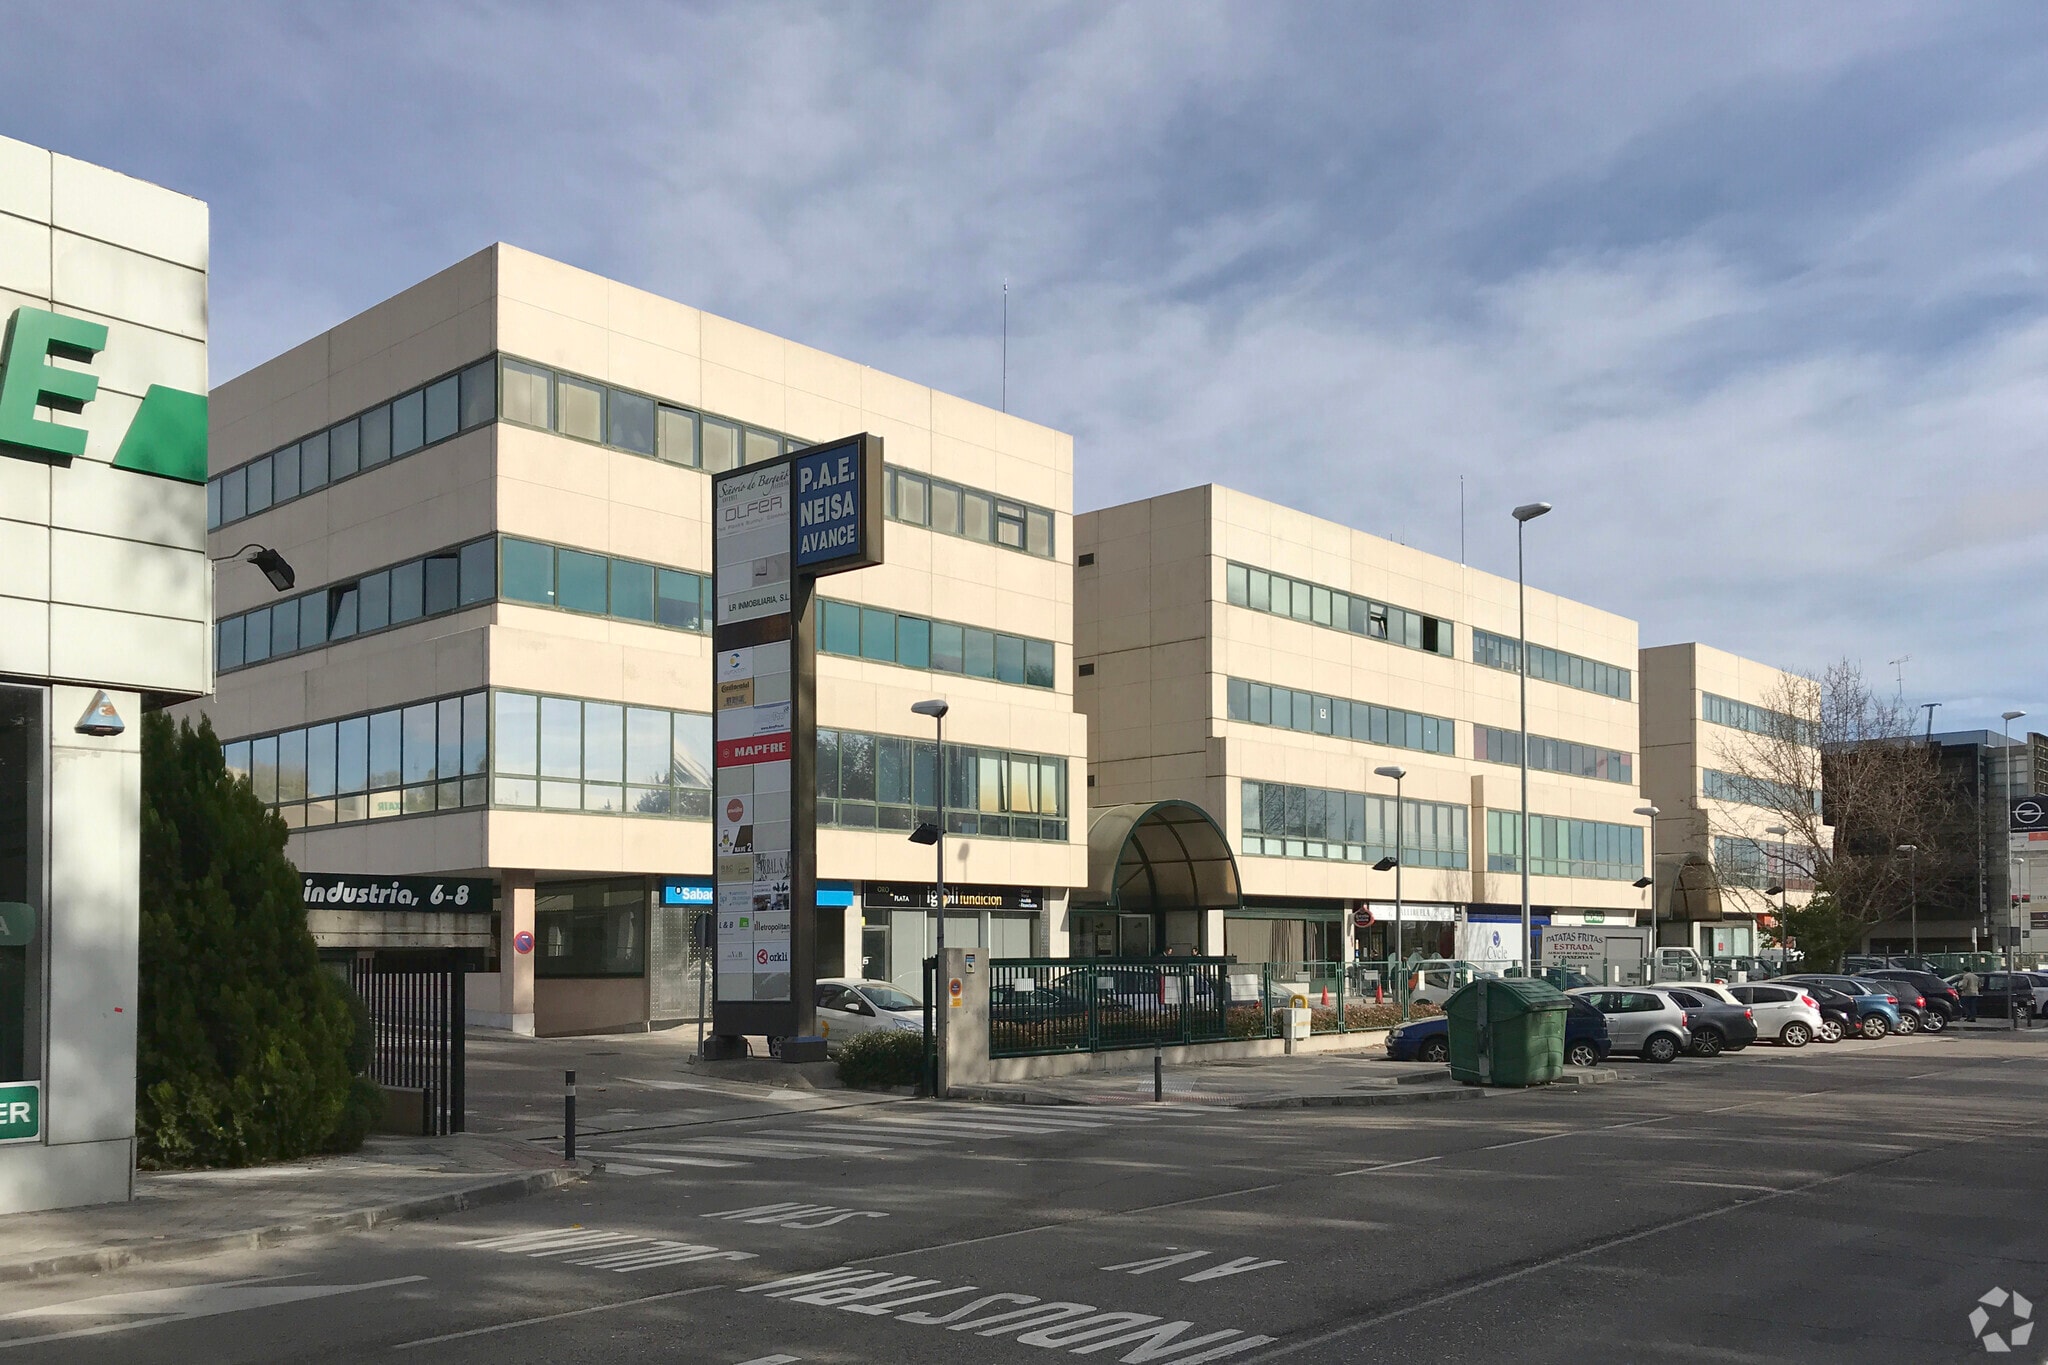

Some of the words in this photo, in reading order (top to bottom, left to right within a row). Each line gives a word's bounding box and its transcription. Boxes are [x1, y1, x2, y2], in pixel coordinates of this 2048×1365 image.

[800, 456, 855, 493] P.A.E.
[800, 490, 855, 528] NEISA
[801, 523, 856, 555] AVANCE
[734, 742, 787, 758] MAPFRE
[303, 878, 420, 906] industria,
[429, 884, 470, 906] 6-8
[1553, 943, 1595, 951] ESTRADA
[1577, 932, 1604, 944] FRITAS
[769, 951, 788, 962] orkli
[735, 1266, 1280, 1365] INDUSTRIA
